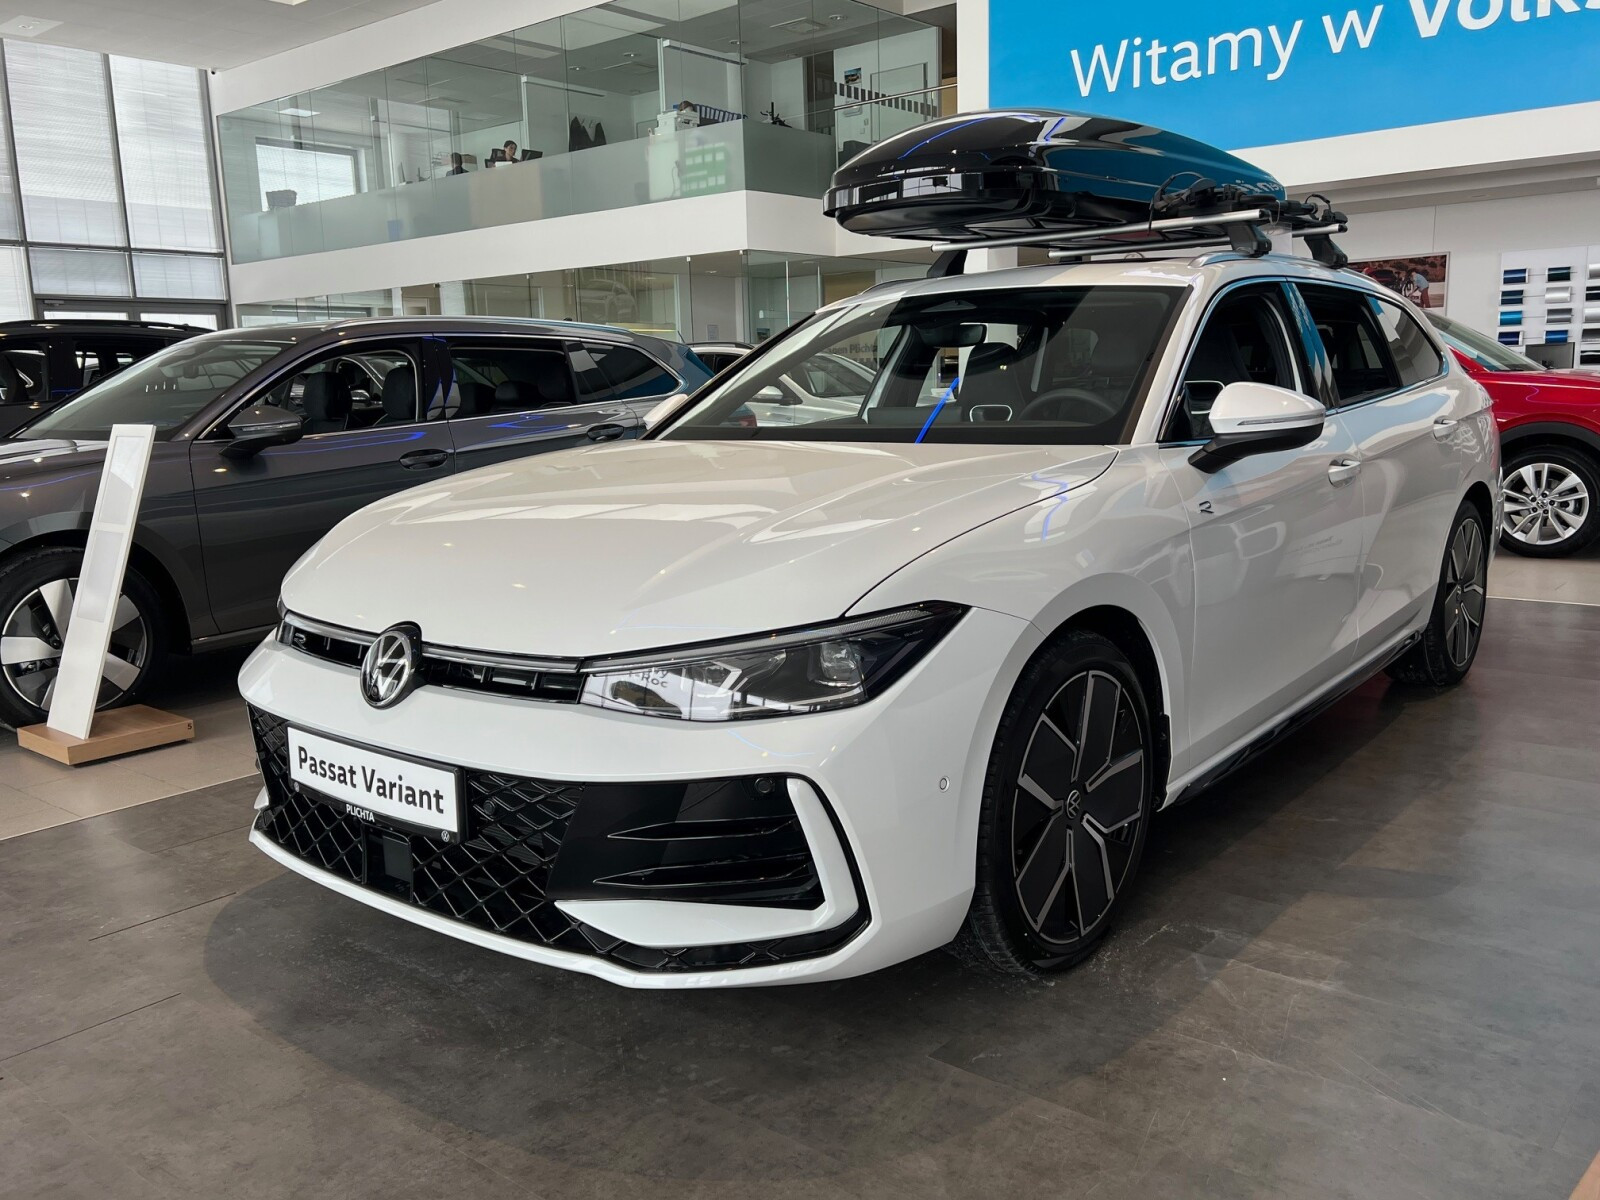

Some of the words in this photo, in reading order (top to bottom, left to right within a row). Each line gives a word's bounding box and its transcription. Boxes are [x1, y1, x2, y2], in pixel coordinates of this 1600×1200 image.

[1070, 19, 1303, 97] Witamy
[1322, 4, 1384, 54] w
[298, 745, 357, 789] Passat
[361, 765, 444, 814] Variant
[345, 803, 375, 823] PLICHTA
